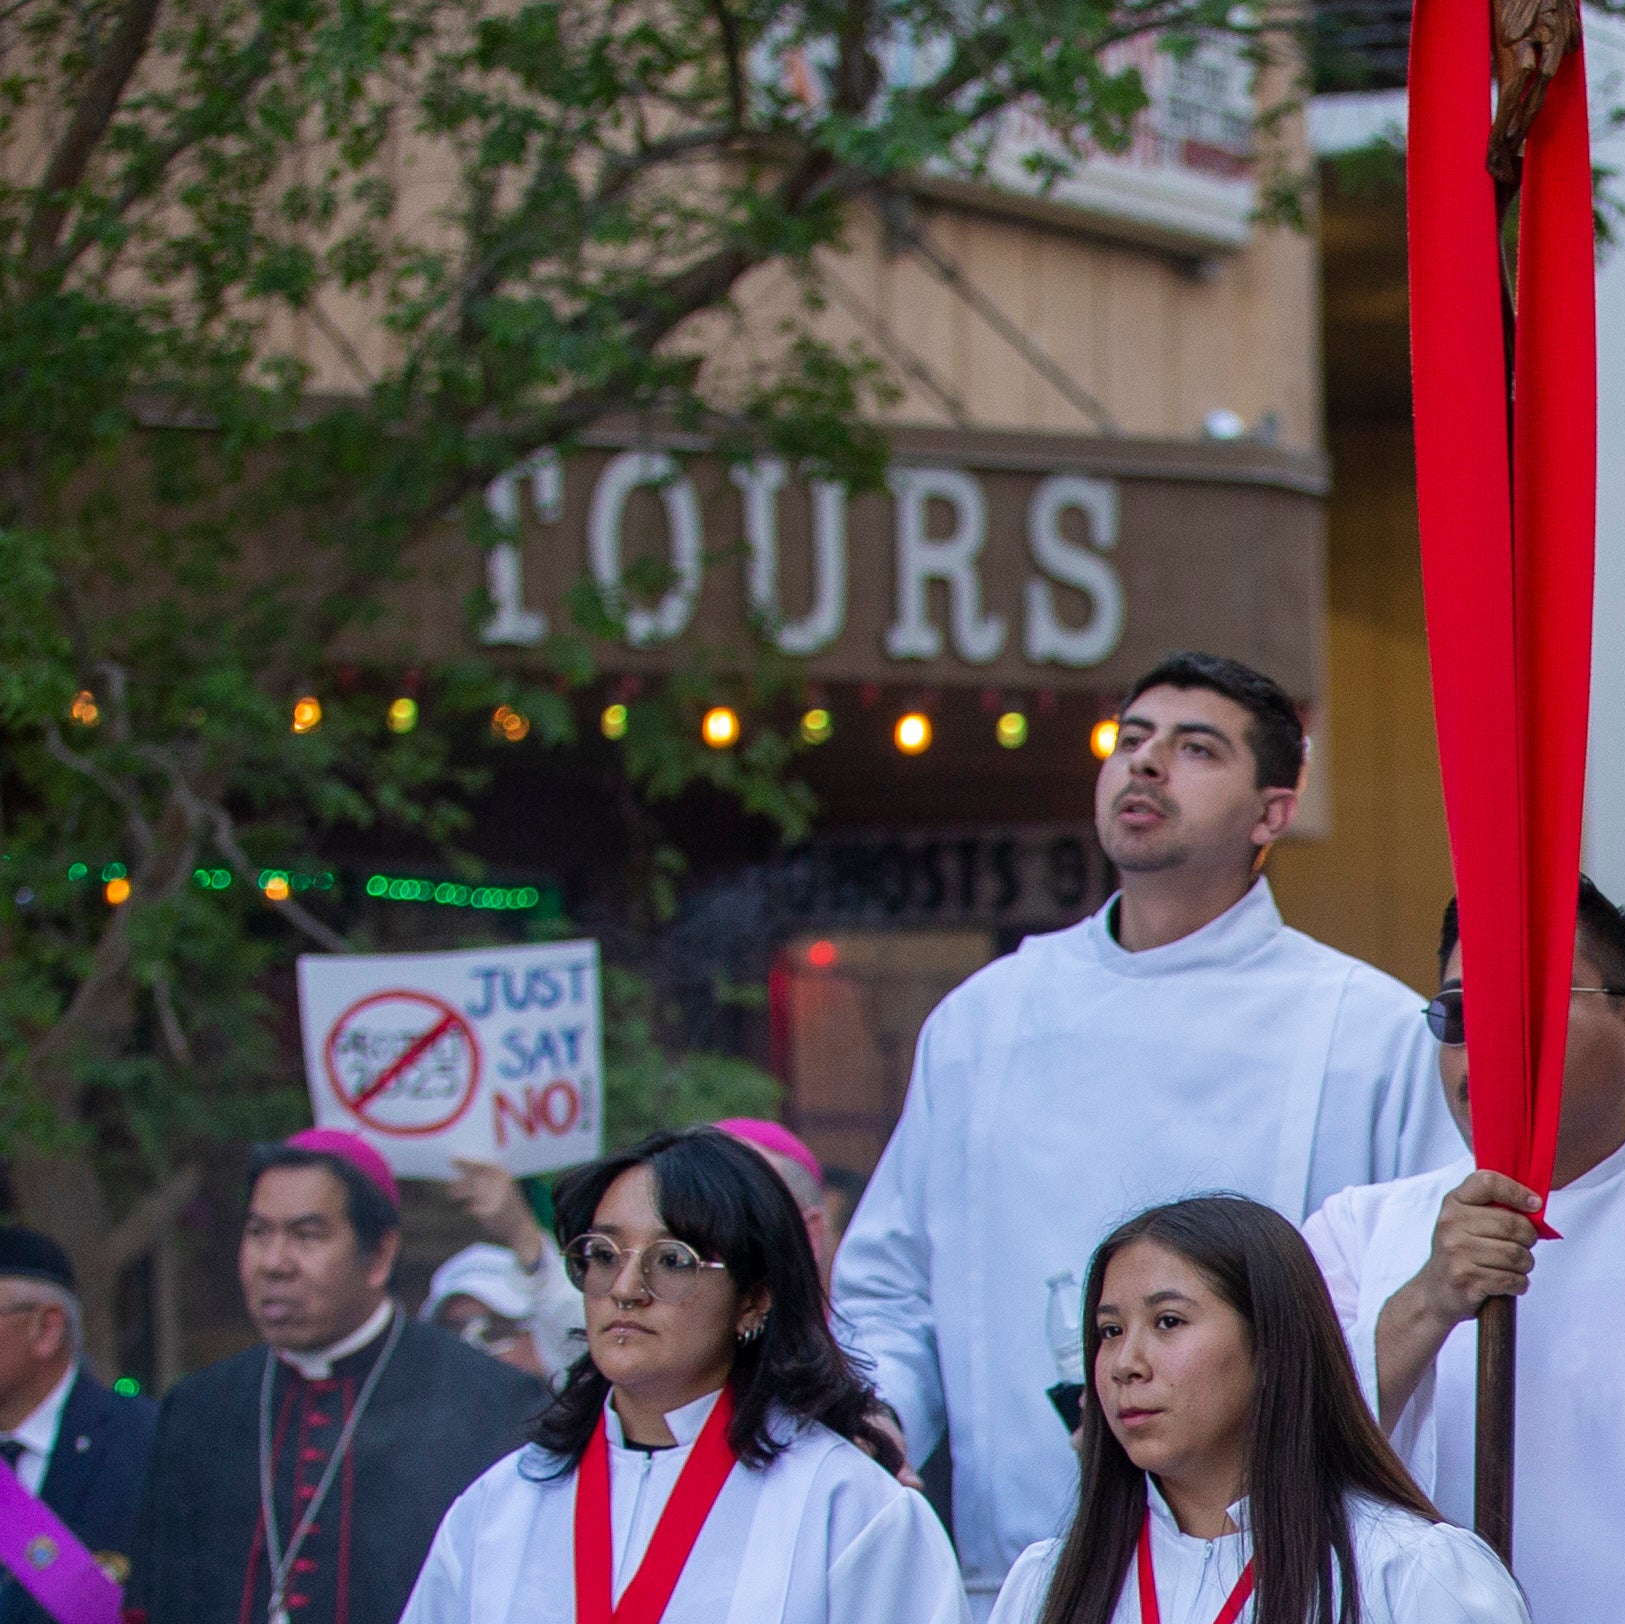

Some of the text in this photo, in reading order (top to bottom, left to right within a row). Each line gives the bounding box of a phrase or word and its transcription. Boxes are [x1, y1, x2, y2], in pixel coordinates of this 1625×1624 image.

[474, 447, 1128, 668] TOURS
[465, 962, 592, 1018] JUST
[497, 1027, 584, 1079] SAY
